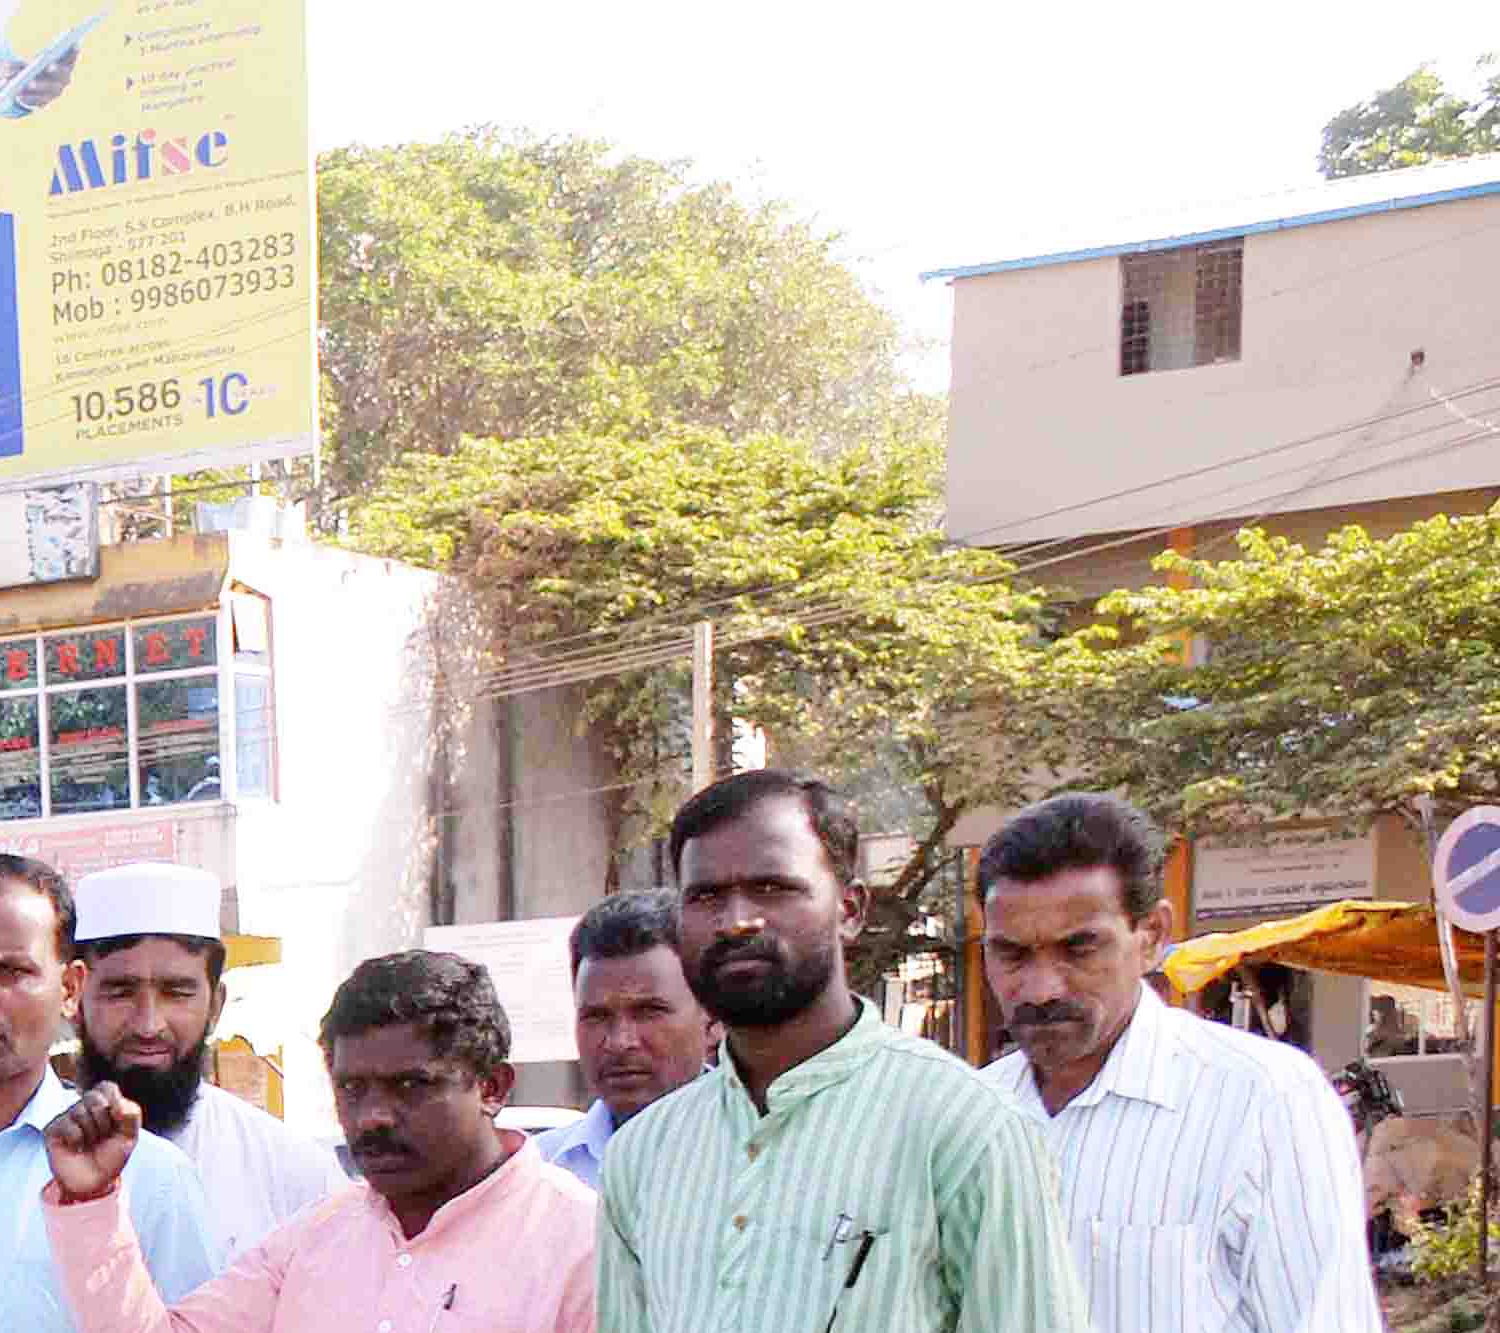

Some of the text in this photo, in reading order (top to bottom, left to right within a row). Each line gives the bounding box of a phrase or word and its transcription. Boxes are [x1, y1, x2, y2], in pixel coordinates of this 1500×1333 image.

[52, 231, 296, 295] Ph: 08182-403283
[52, 295, 105, 327] Mob
[130, 263, 296, 313] 9986073933
[71, 377, 182, 424] 10,586
[74, 414, 184, 442] PLACEMENTS
